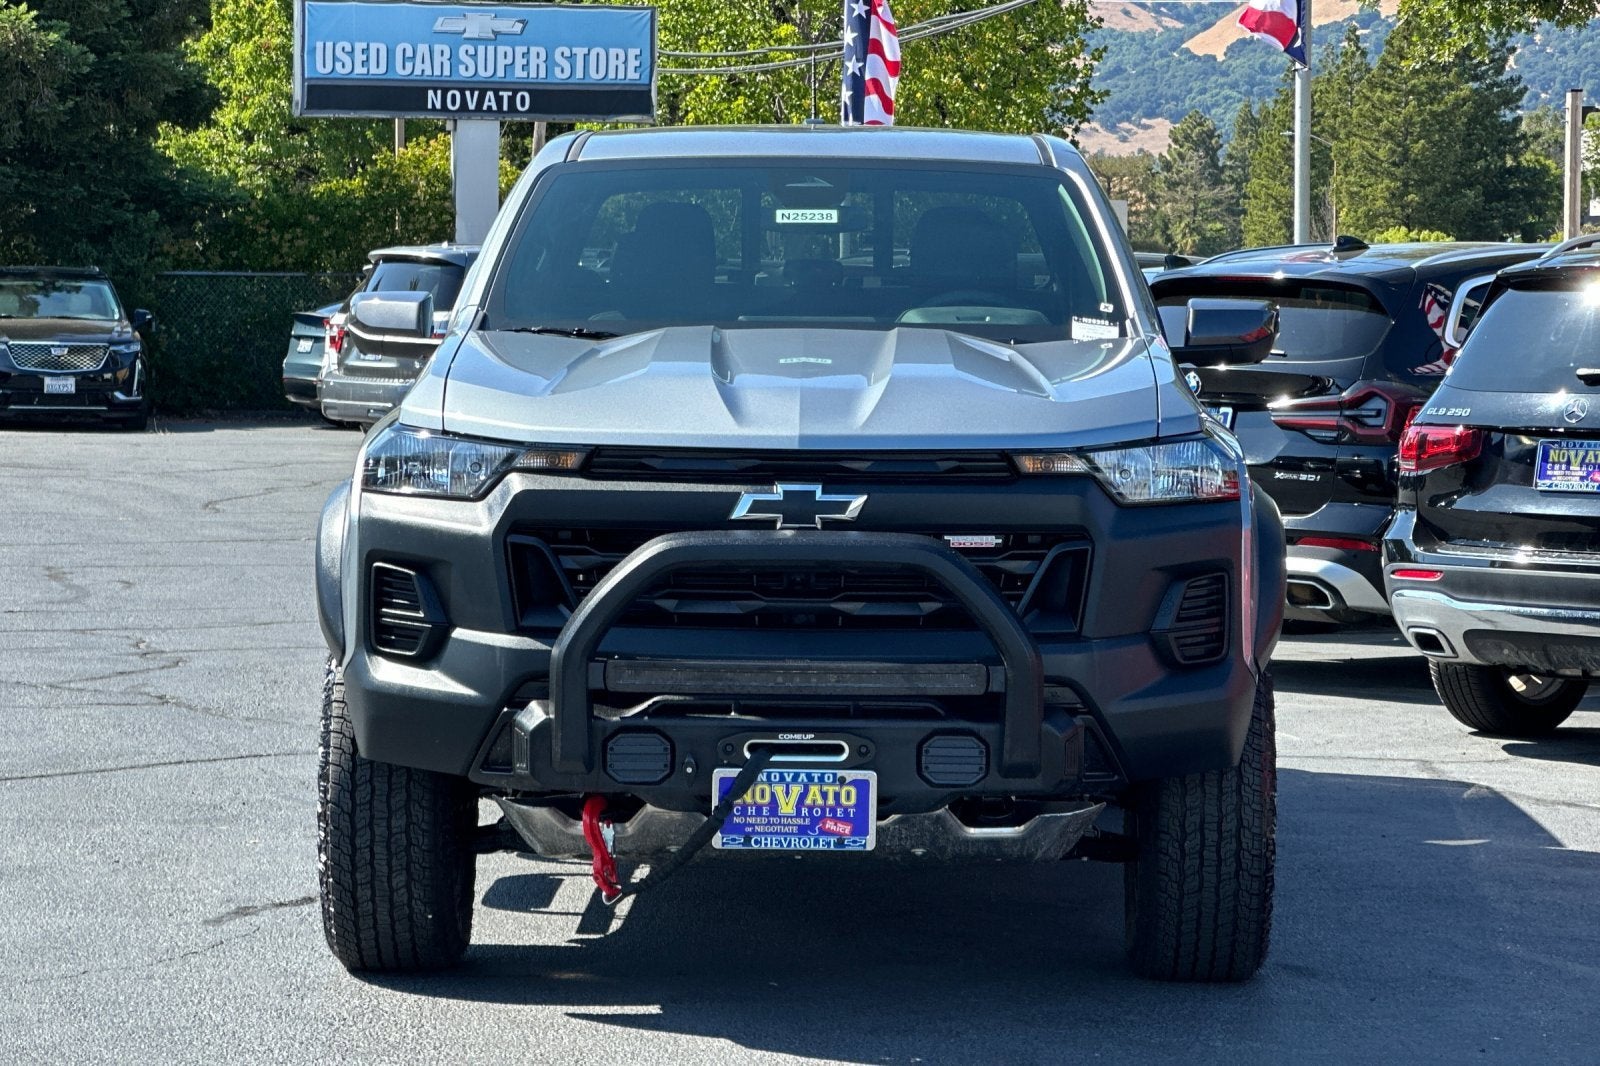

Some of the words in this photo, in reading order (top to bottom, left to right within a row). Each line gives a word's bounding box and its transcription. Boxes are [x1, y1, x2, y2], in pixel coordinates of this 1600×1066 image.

[315, 41, 388, 75] USED
[395, 43, 451, 77] CAR
[458, 44, 548, 79] SUPER
[554, 46, 642, 81] STORE
[427, 90, 531, 112] NOVATO
[781, 212, 833, 221] N25238
[1426, 407, 1446, 415] GLB
[1447, 408, 1471, 417] 250
[757, 772, 833, 783] NOVATO
[746, 817, 768, 825] NEED
[769, 817, 780, 825] TO
[781, 817, 811, 825] HASSLE
[754, 825, 798, 834] NEGOTIATE
[825, 822, 851, 835] PRICE
[751, 837, 837, 849] CHEVROLET
